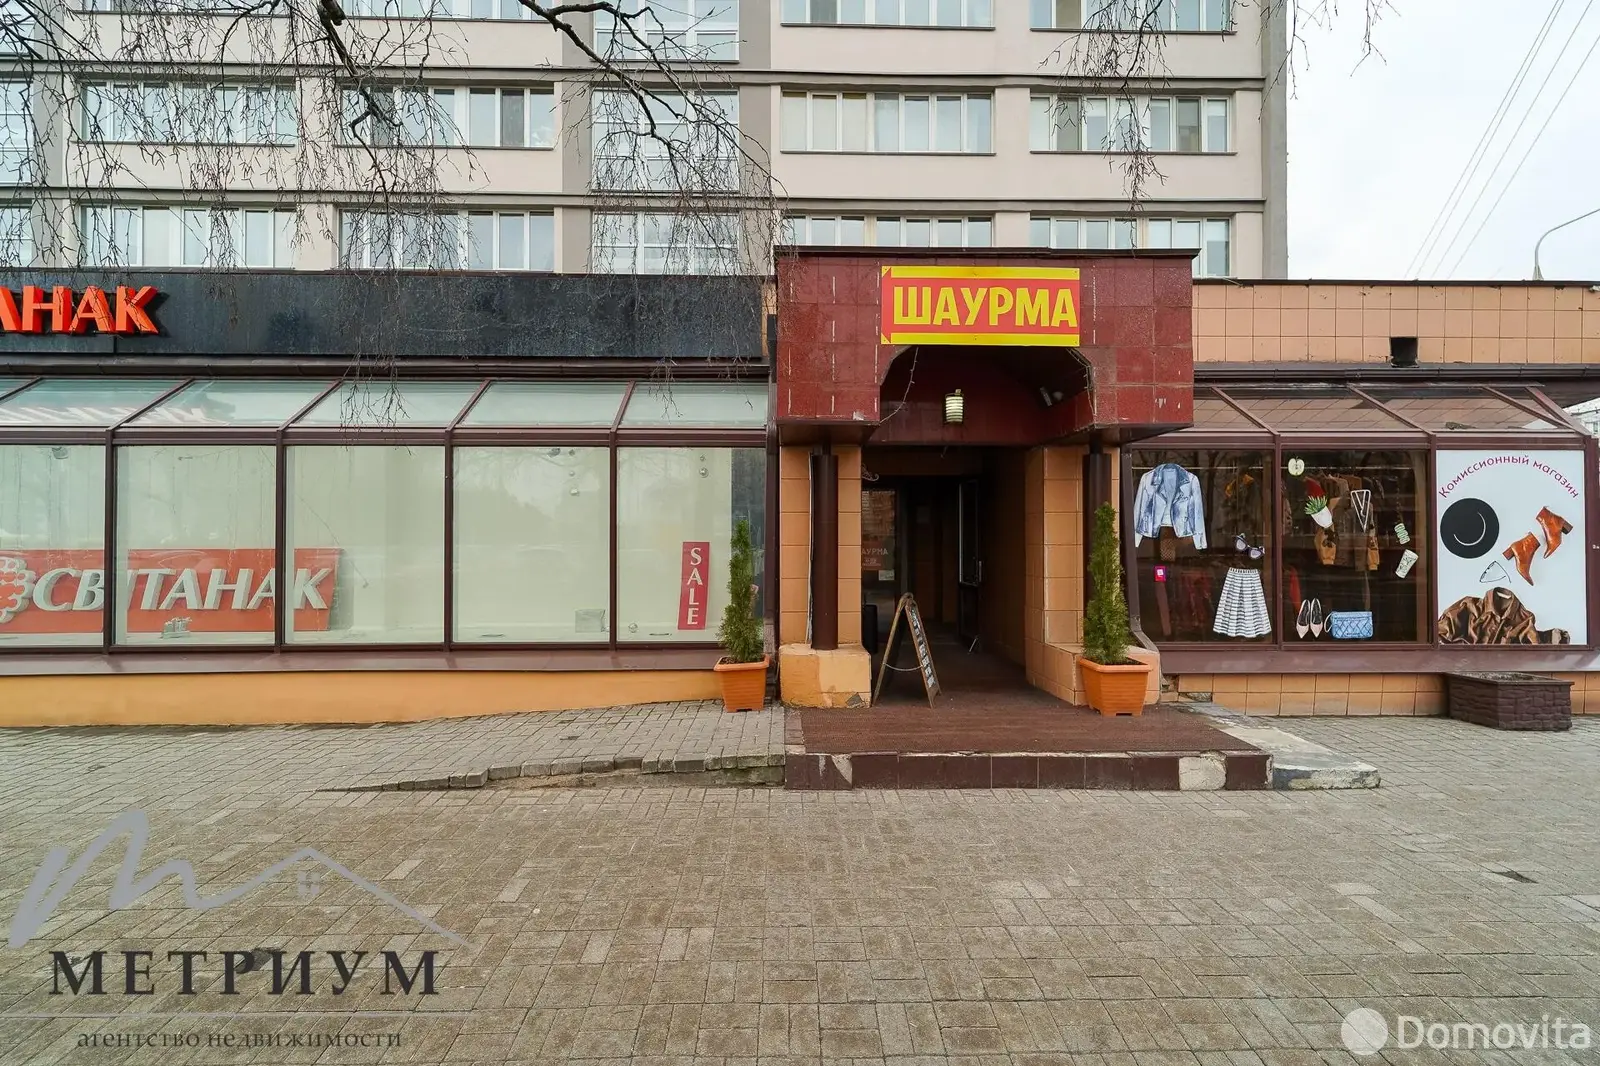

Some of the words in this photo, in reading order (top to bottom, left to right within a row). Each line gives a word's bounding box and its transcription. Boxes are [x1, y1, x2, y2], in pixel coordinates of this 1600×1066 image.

[893, 286, 1078, 328] ШАУРМА
[1438, 455, 1530, 499] Комиссионный
[1532, 460, 1579, 499] магазин
[32, 567, 333, 611] СВТАНАК
[686, 547, 703, 625] SALE
